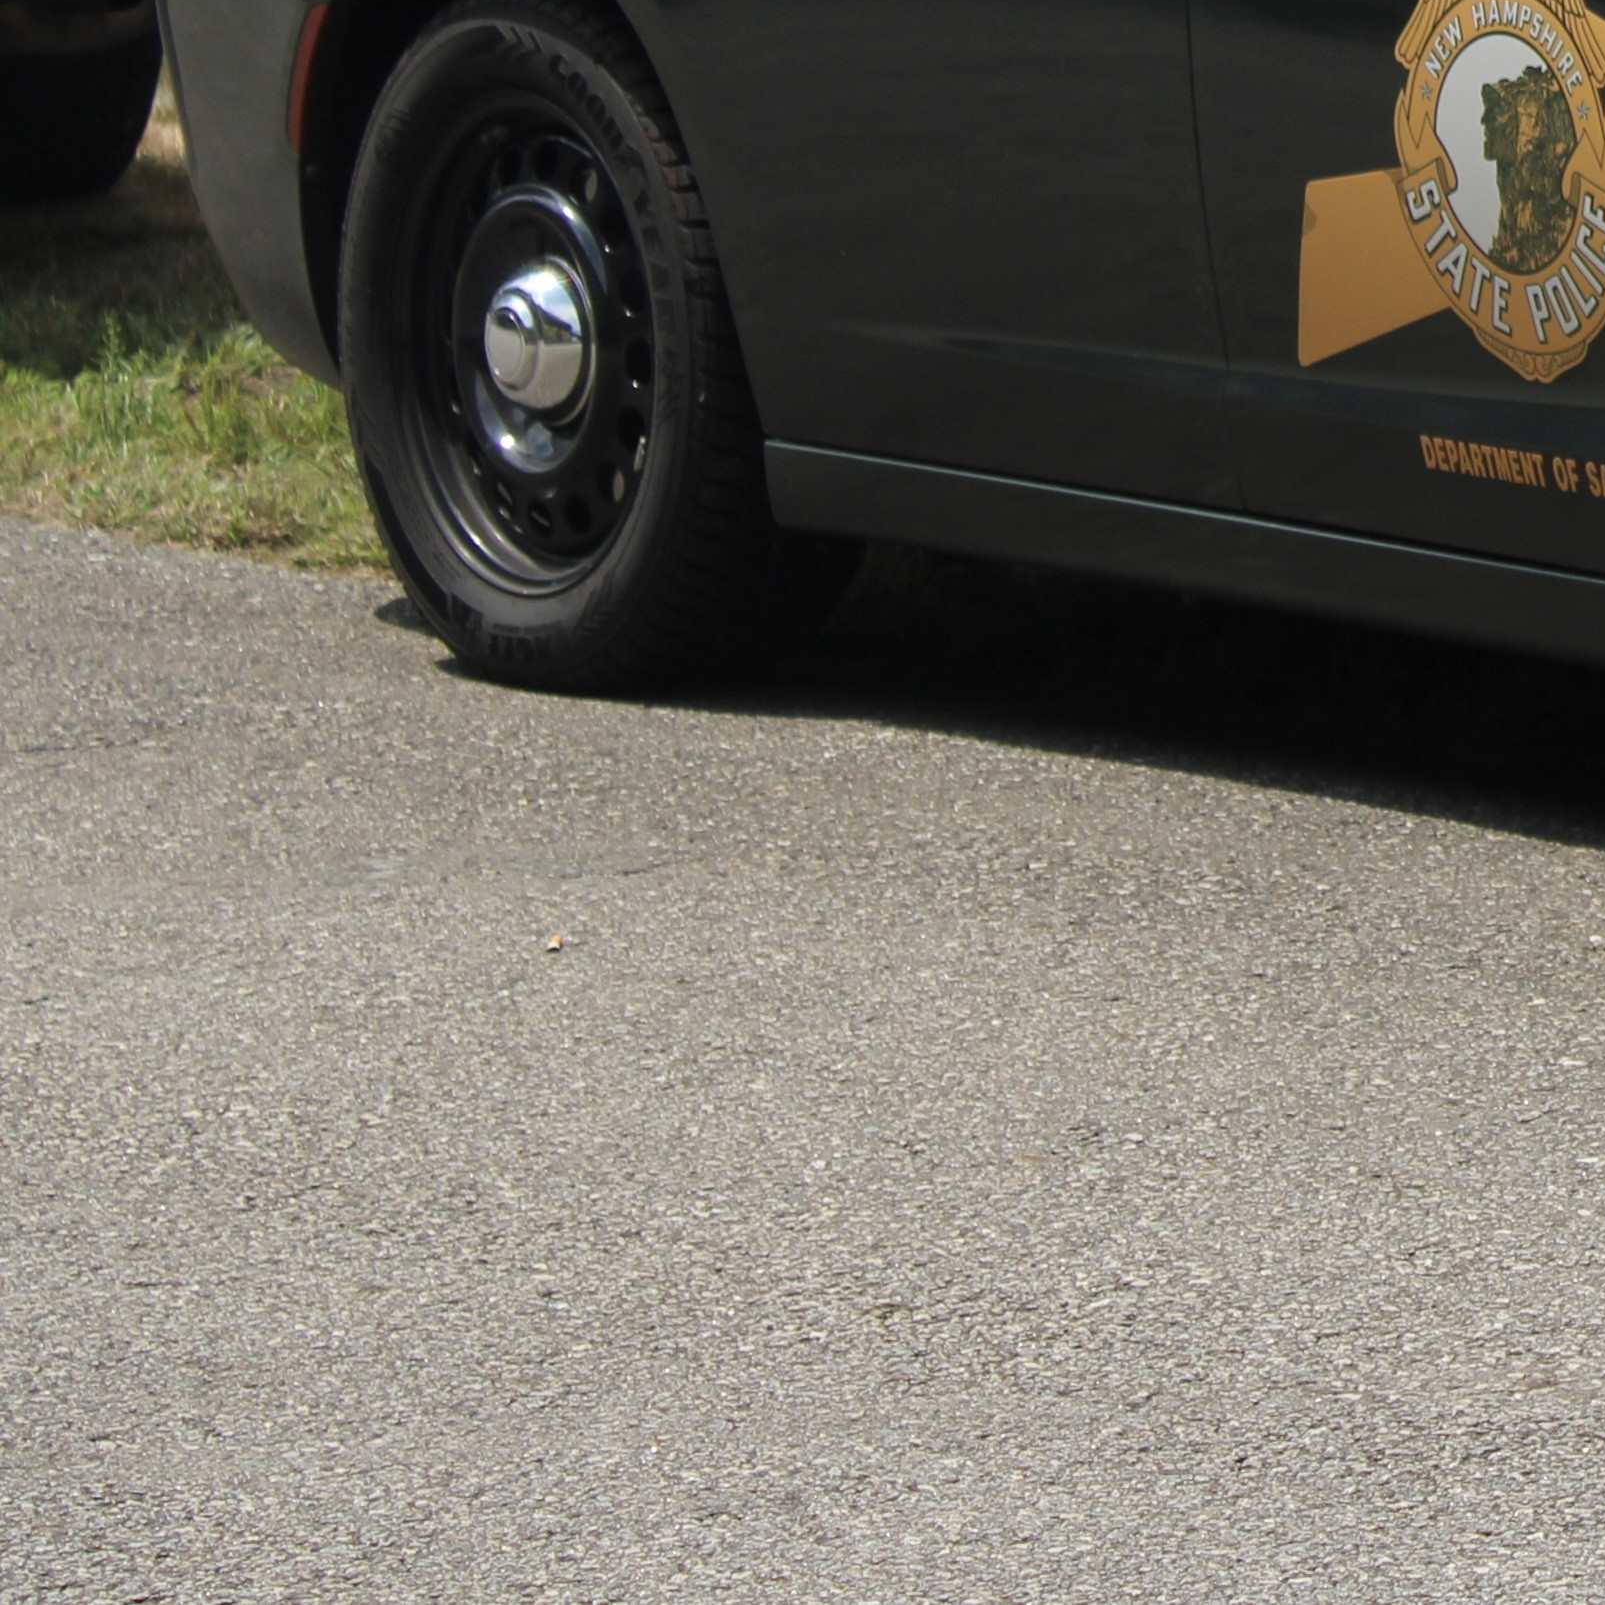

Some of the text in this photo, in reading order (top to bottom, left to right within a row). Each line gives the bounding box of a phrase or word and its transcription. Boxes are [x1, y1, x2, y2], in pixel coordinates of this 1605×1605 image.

[1424, 14, 1463, 79] NEW
[1406, 178, 1514, 337] STATE
[1420, 435, 1545, 490] DEPARTMENT
[1552, 457, 1580, 493] OF
